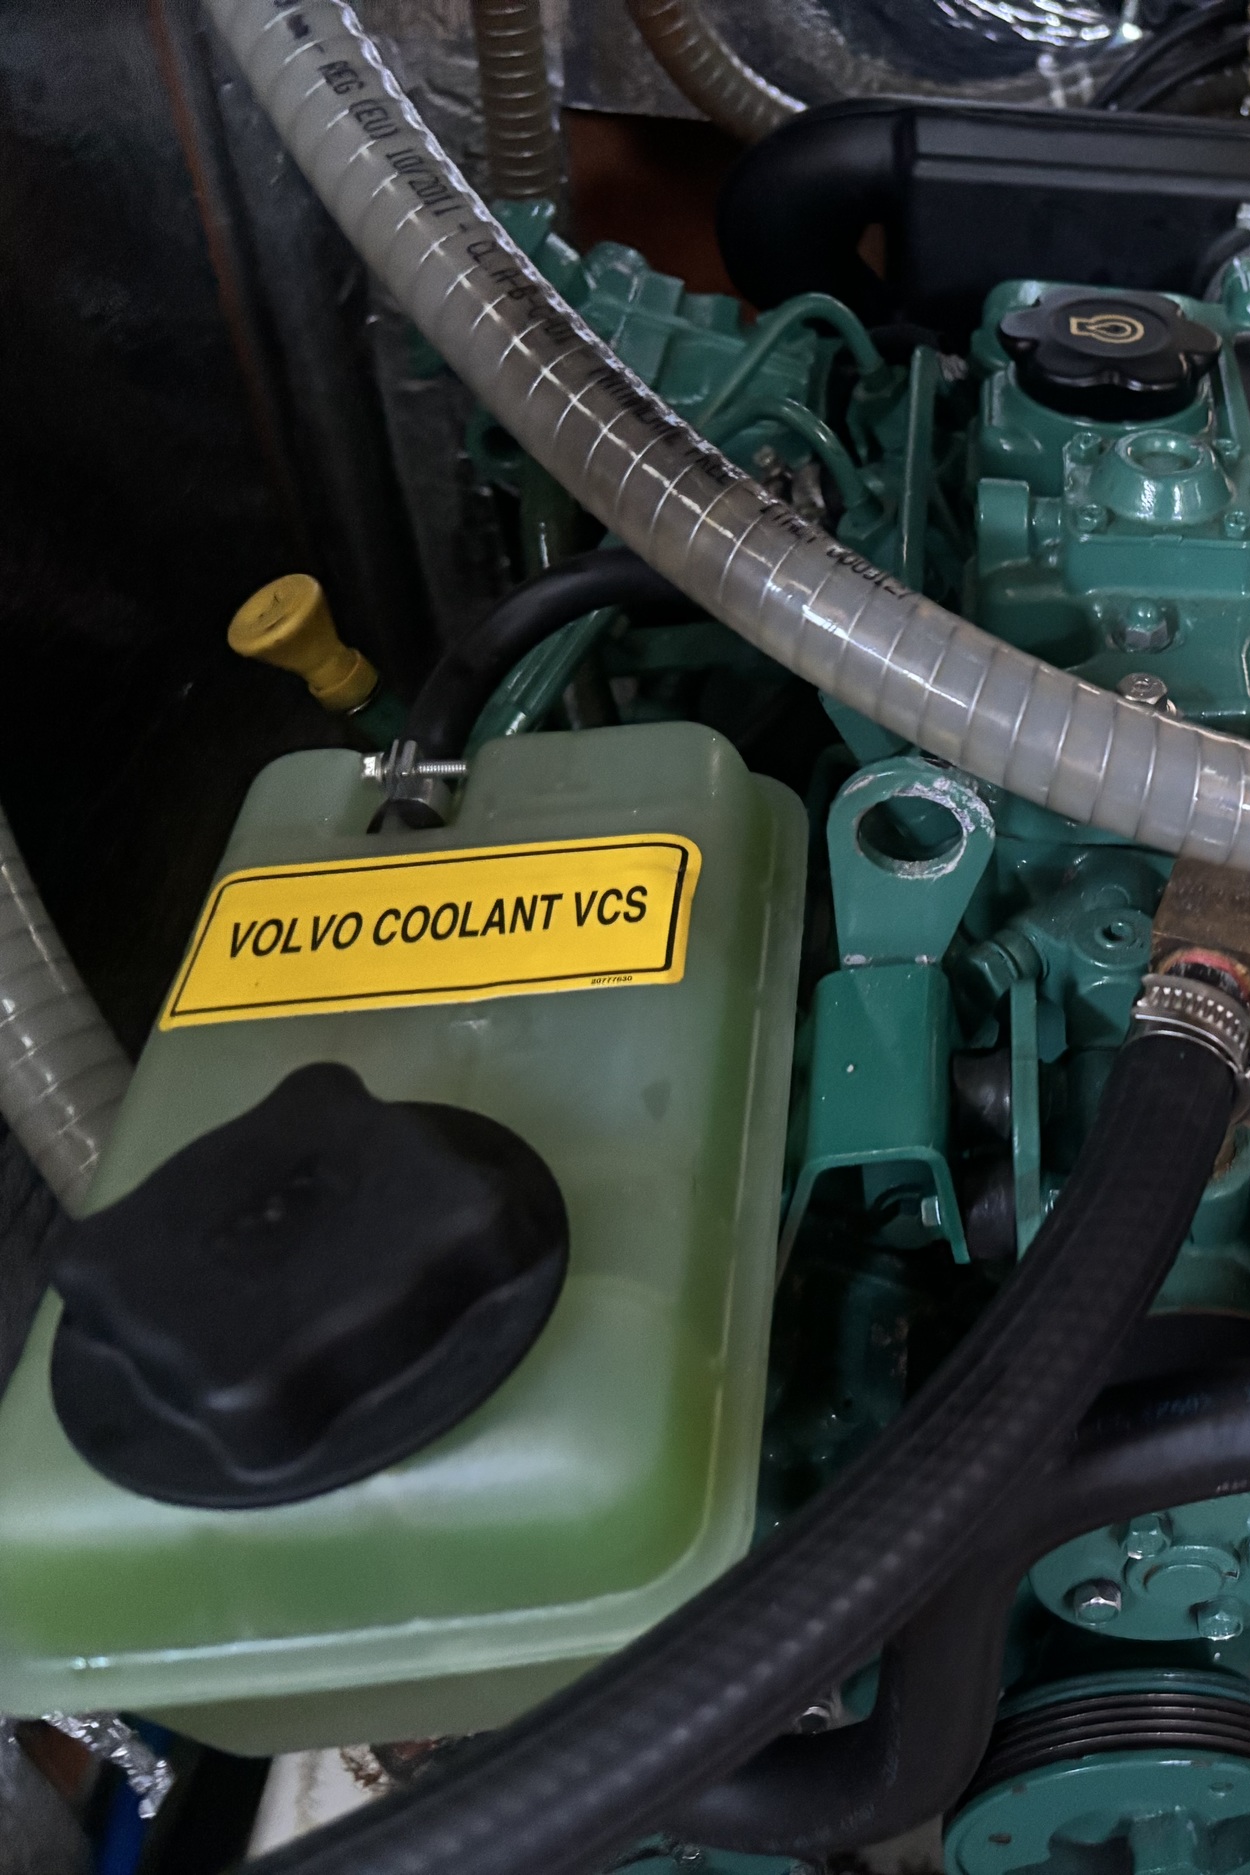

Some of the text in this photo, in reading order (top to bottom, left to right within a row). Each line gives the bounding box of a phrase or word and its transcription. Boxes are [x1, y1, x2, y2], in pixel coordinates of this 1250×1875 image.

[229, 885, 648, 958] VOLVO COOLANT VCS
